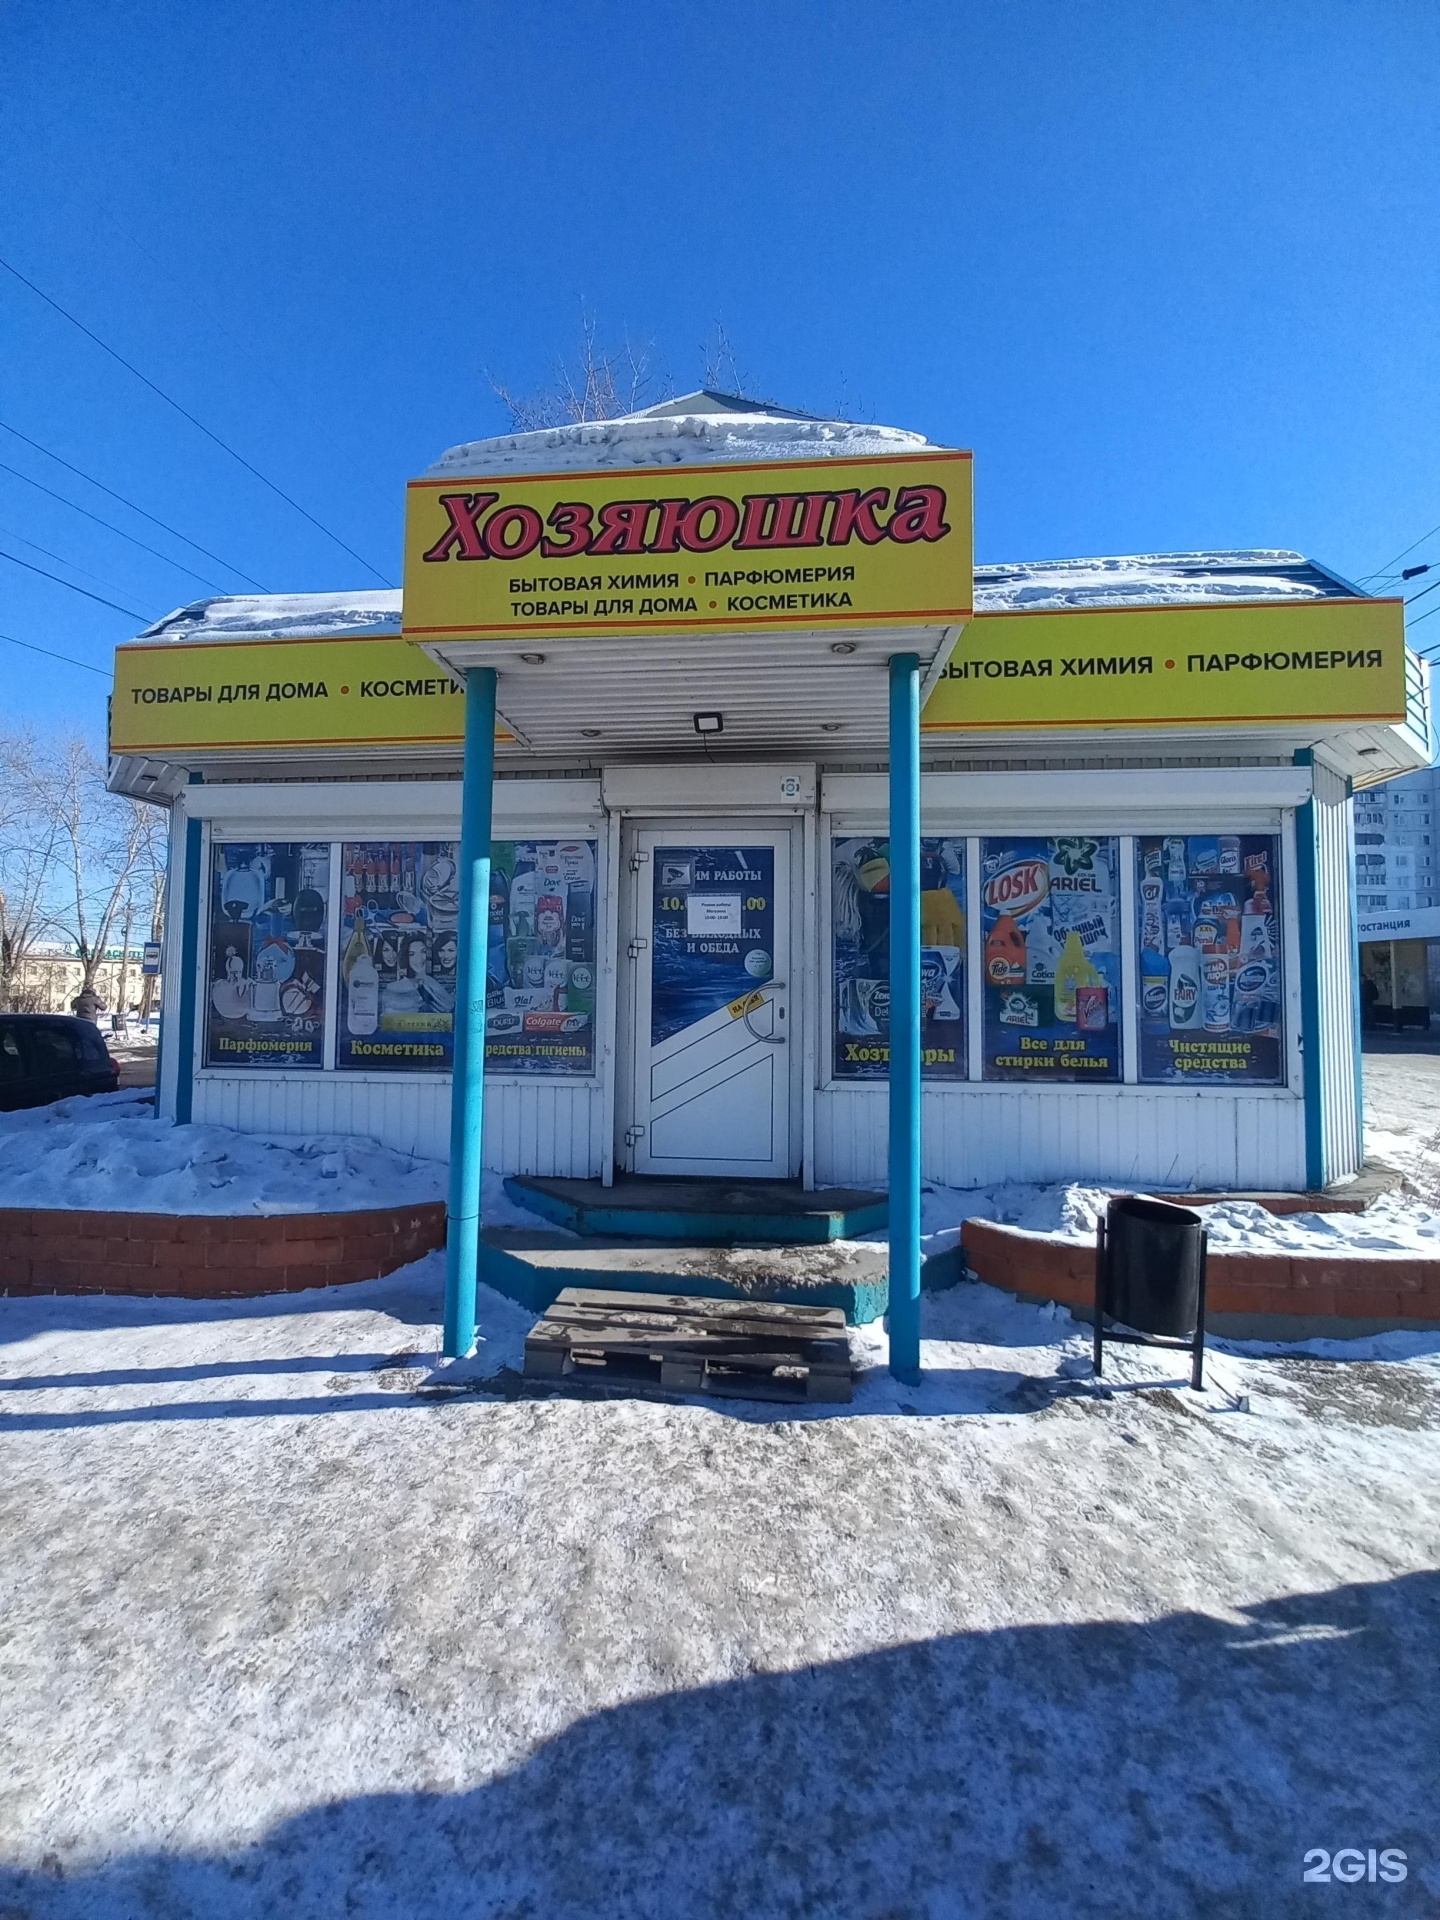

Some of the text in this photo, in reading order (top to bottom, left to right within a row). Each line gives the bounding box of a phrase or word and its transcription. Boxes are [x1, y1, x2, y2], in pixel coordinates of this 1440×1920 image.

[423, 484, 951, 562] Хозяюшка
[508, 566, 856, 593] БЫТОВАЯ ХИМИЯ ПАРФЮМЕРИЯ
[511, 593, 853, 617] ТОВАРЫ ДЛЯ ДОМА КОСМЕТИКА
[1060, 655, 1153, 676] ХИМИЯ
[1186, 649, 1383, 673] ПАРФЮМЕРИЯ
[131, 678, 465, 704] ТОВАРЫ ДЛЯ ДОМА КОСМЕТИ
[713, 870, 762, 881] РАБОТЫ
[988, 863, 1040, 906] LOSK
[1050, 877, 1103, 893] ARIEL
[1358, 919, 1411, 932] останция
[665, 928, 687, 939] БЕЗ
[686, 942, 740, 953] И ОБЕДА
[1173, 988, 1197, 1001] FAIRY
[526, 1016, 562, 1027] Colgate
[219, 1037, 313, 1054] Парфюмерия
[350, 1040, 445, 1056] Косметика
[1020, 1036, 1086, 1051] Все для
[1168, 1039, 1252, 1054] Чистящие
[485, 1045, 587, 1058] редства гигиены
[995, 1054, 1109, 1069] стирки белья
[1174, 1057, 1247, 1071] средства
